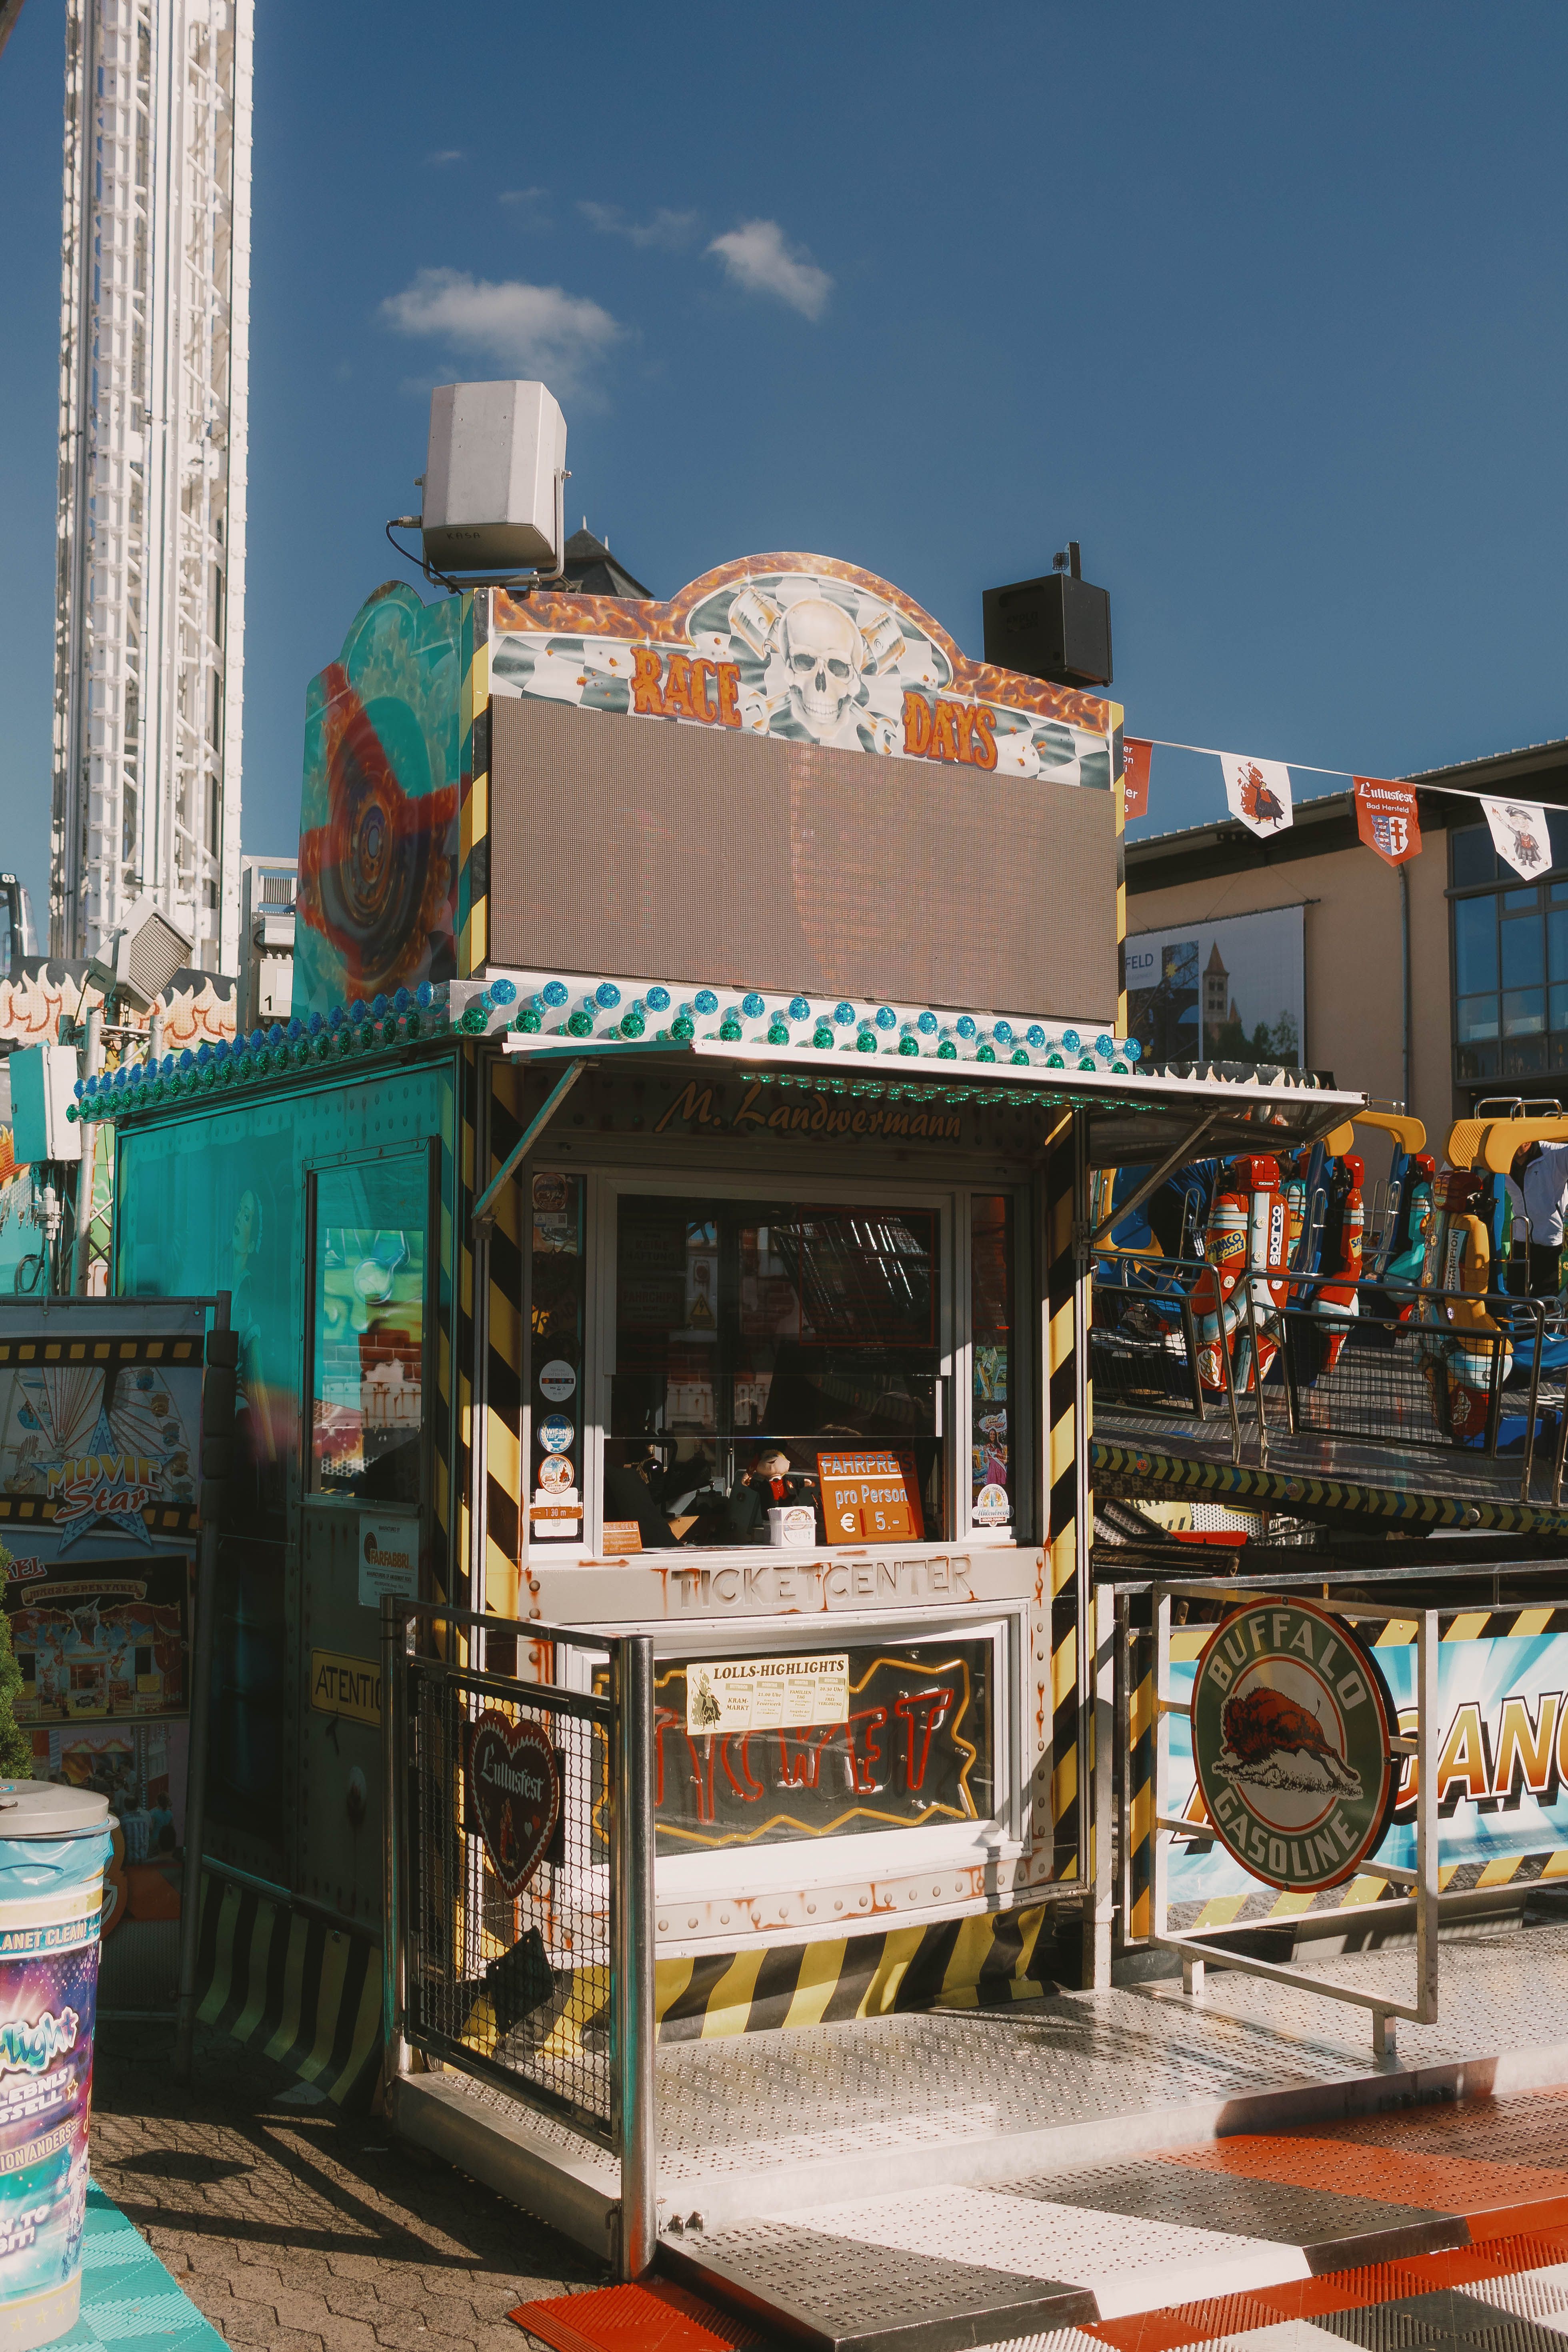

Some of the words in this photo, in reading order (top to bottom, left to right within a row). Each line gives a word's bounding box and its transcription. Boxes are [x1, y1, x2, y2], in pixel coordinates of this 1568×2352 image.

[630, 645, 743, 728] RACE
[902, 690, 998, 770] DAYS
[1358, 782, 1414, 804] Lullusfest
[1366, 802, 1380, 810] Bad
[1382, 804, 1409, 813] Hersfeld
[2, 874, 16, 884] 03
[264, 995, 272, 1011] 1
[654, 1080, 721, 1133] M.
[733, 1082, 960, 1138] Landwermann
[1206, 1232, 1242, 1256] SAMCO
[1269, 1203, 1284, 1266] sparco
[1218, 1239, 1244, 1260] sport
[822, 1453, 913, 1474] FAHRPREIS
[46, 1454, 164, 1500] MOVIE
[53, 1477, 150, 1523] Star
[835, 1490, 858, 1510] pro
[861, 1484, 908, 1503] Person
[545, 1508, 558, 1517] 1.30
[840, 1513, 856, 1532] €
[370, 1548, 409, 1569] FARFABBRI
[713, 1660, 844, 1680] LOLLS-HIGHLIGHTS
[1207, 1613, 1367, 1710] BUFFALO
[480, 1741, 545, 1802] Lullusfest
[1214, 1787, 1360, 1877] GASOLINE
[0, 1931, 42, 1950] ANET
[46, 1922, 87, 1945] CLEAN!
[20, 2204, 50, 2229] TO
